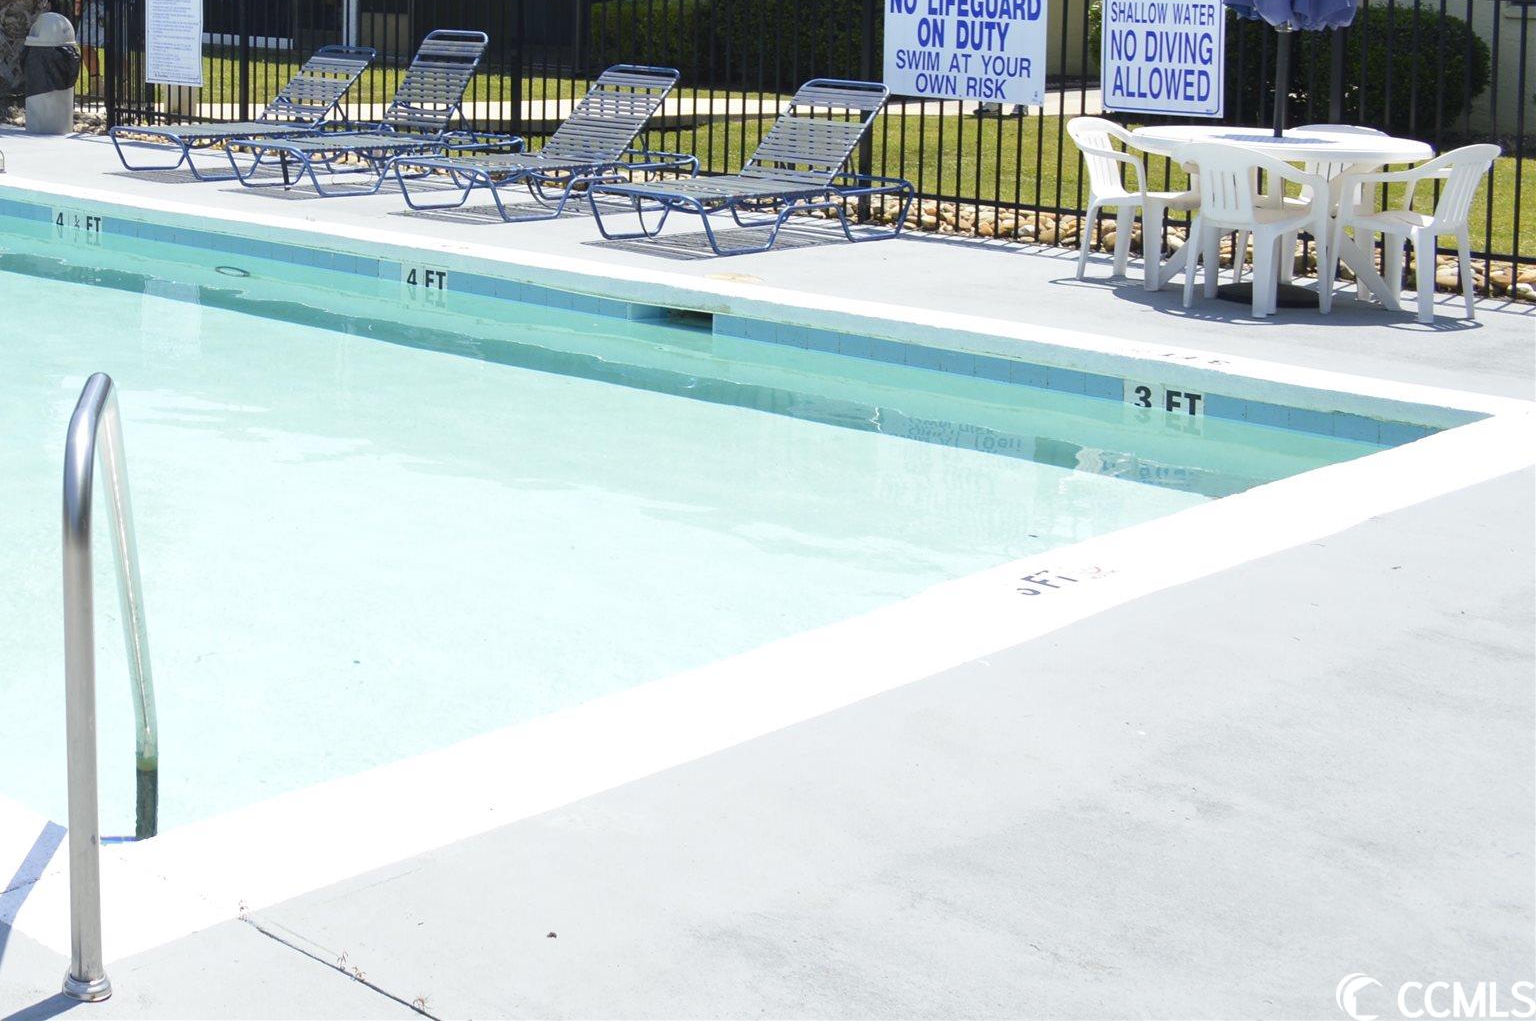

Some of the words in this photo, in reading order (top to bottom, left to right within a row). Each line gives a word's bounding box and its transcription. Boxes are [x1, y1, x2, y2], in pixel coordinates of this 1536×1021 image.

[1111, 1, 1168, 24] SHALLOW
[1173, 3, 1215, 26] WATER
[917, 17, 945, 48] ON
[956, 19, 1010, 52] DUTY
[1111, 29, 1137, 62] NO
[1145, 30, 1213, 66] DIVING
[896, 49, 940, 72] SWIM
[949, 53, 972, 73] AT
[981, 55, 1032, 78] YOUR
[915, 73, 957, 95] OWN
[966, 77, 1007, 99] RISK
[1112, 65, 1211, 102] ALLOWED
[56, 212, 64, 226] 4
[86, 215, 102, 232] FT
[407, 268, 418, 285] 4
[425, 269, 447, 290] FT
[1134, 385, 1152, 408] 3
[1166, 389, 1202, 416] FT
